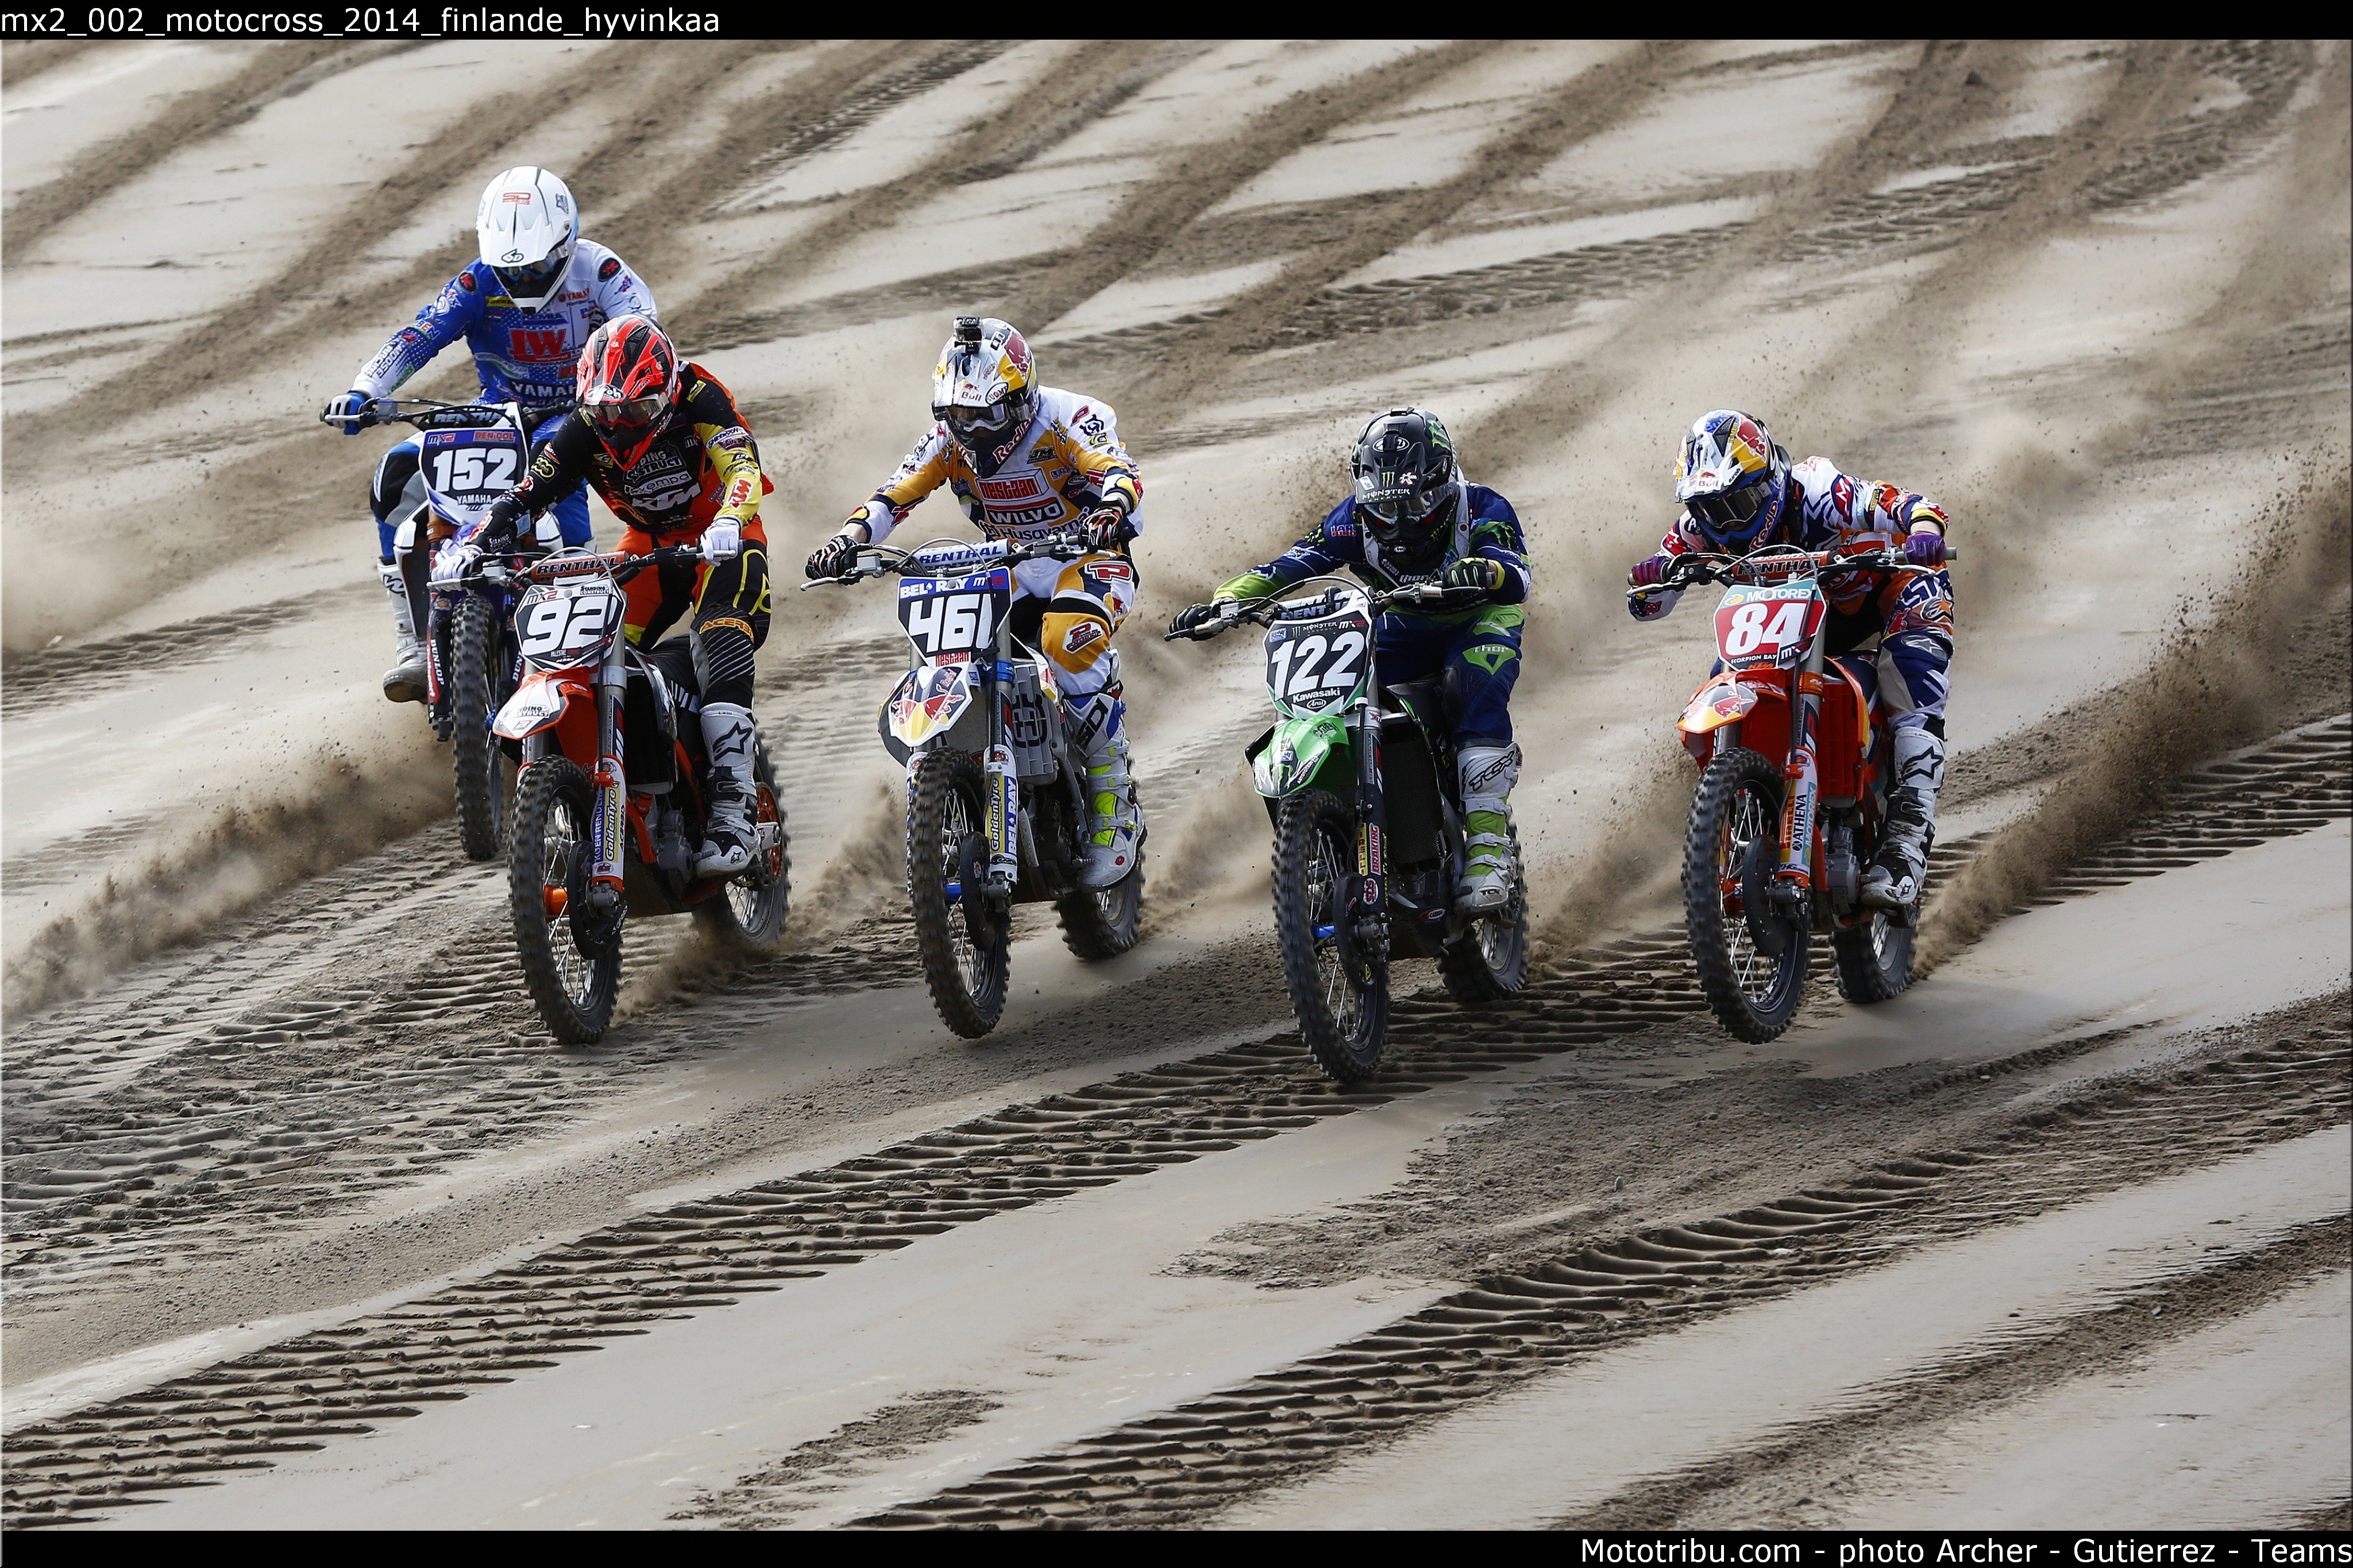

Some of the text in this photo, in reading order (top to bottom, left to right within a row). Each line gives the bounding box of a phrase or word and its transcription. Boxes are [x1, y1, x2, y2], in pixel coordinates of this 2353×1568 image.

[962, 392, 982, 401] Bull
[433, 448, 517, 493] 152
[457, 495, 493, 504] YAMAHA
[989, 503, 1061, 523] WILVO
[535, 558, 620, 575] RENTHAL
[919, 546, 1003, 563] RENTHAL
[522, 596, 618, 656] 92
[908, 593, 993, 653] 461
[1725, 603, 1807, 656] 84
[430, 639, 445, 685] DUNLOP
[1271, 631, 1365, 702] 122
[1474, 644, 1509, 653] thor
[1293, 688, 1341, 703] Kawasaki
[1468, 750, 1515, 792] TCX
[990, 777, 1000, 852] GoldenTyre
[1008, 778, 1017, 814] RAY
[1793, 794, 1807, 841] ATHENA
[605, 789, 617, 861] GoldenTyre
[1371, 824, 1380, 873] BRAKING
